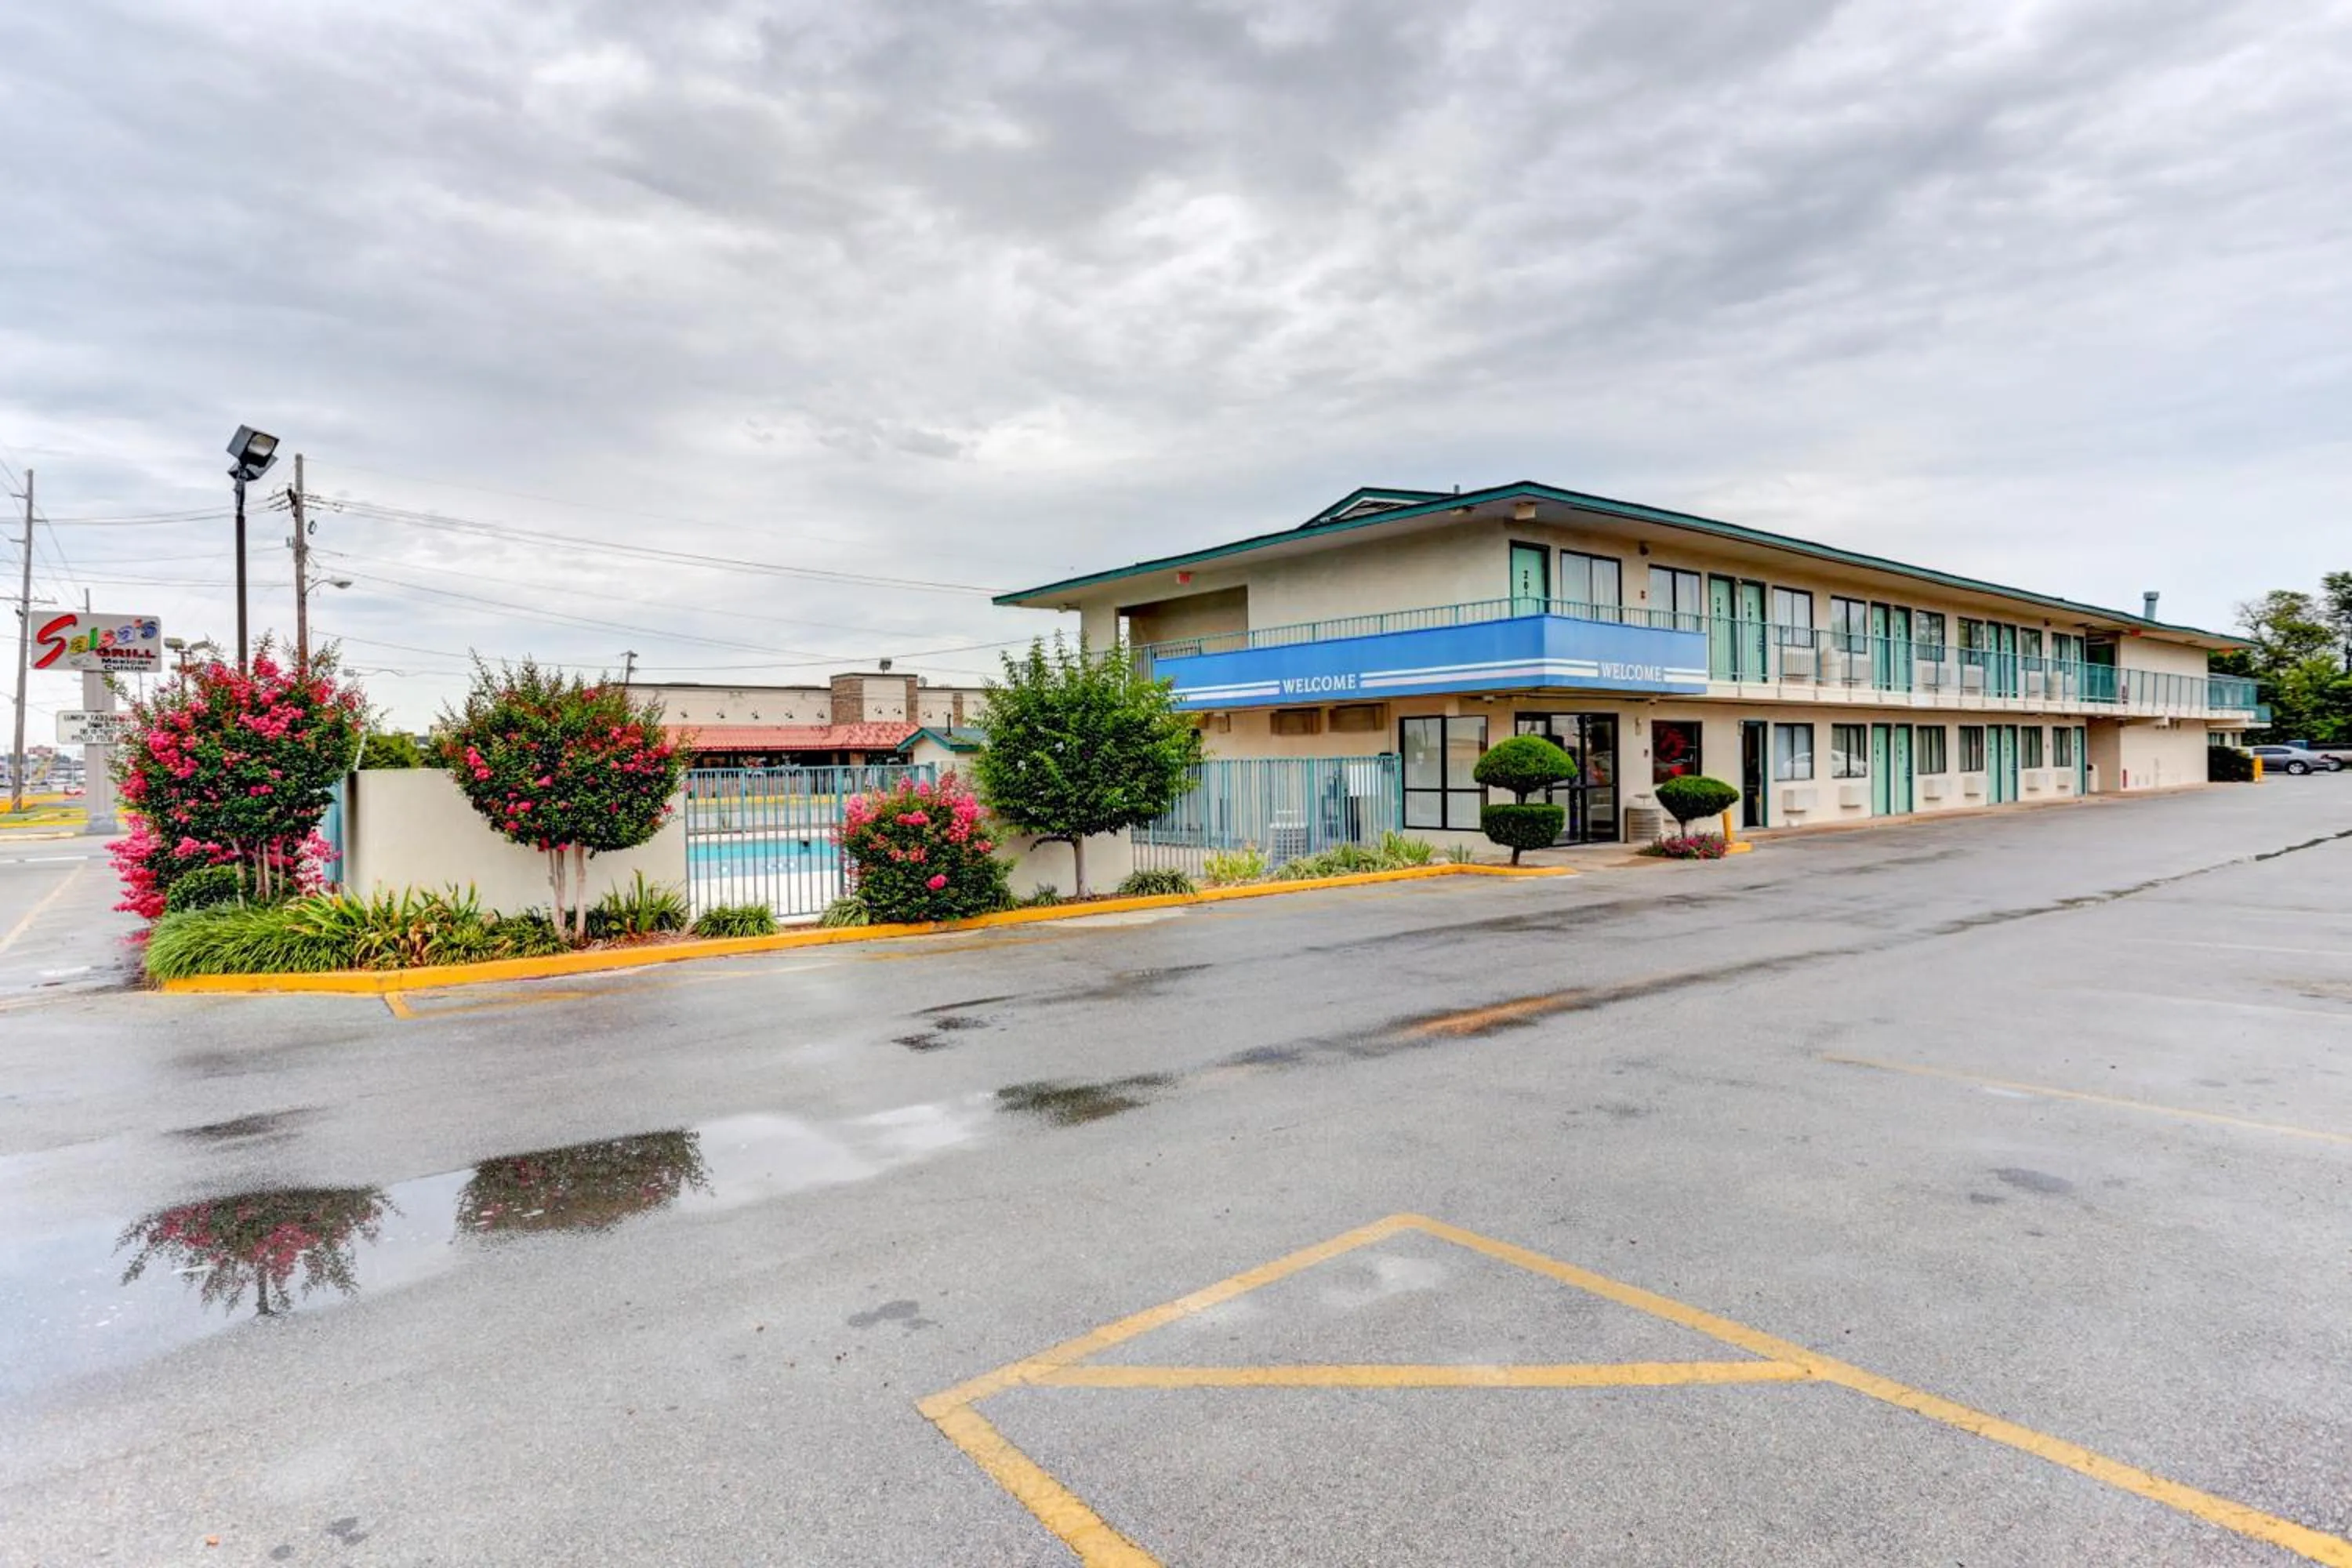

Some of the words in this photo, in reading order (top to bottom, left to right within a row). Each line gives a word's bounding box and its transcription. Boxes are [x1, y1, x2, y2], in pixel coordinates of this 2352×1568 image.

[34, 614, 158, 669] Salsa's
[95, 648, 156, 659] GRILL
[1601, 662, 1662, 682] WELCOME
[1283, 673, 1356, 694] WELCOME
